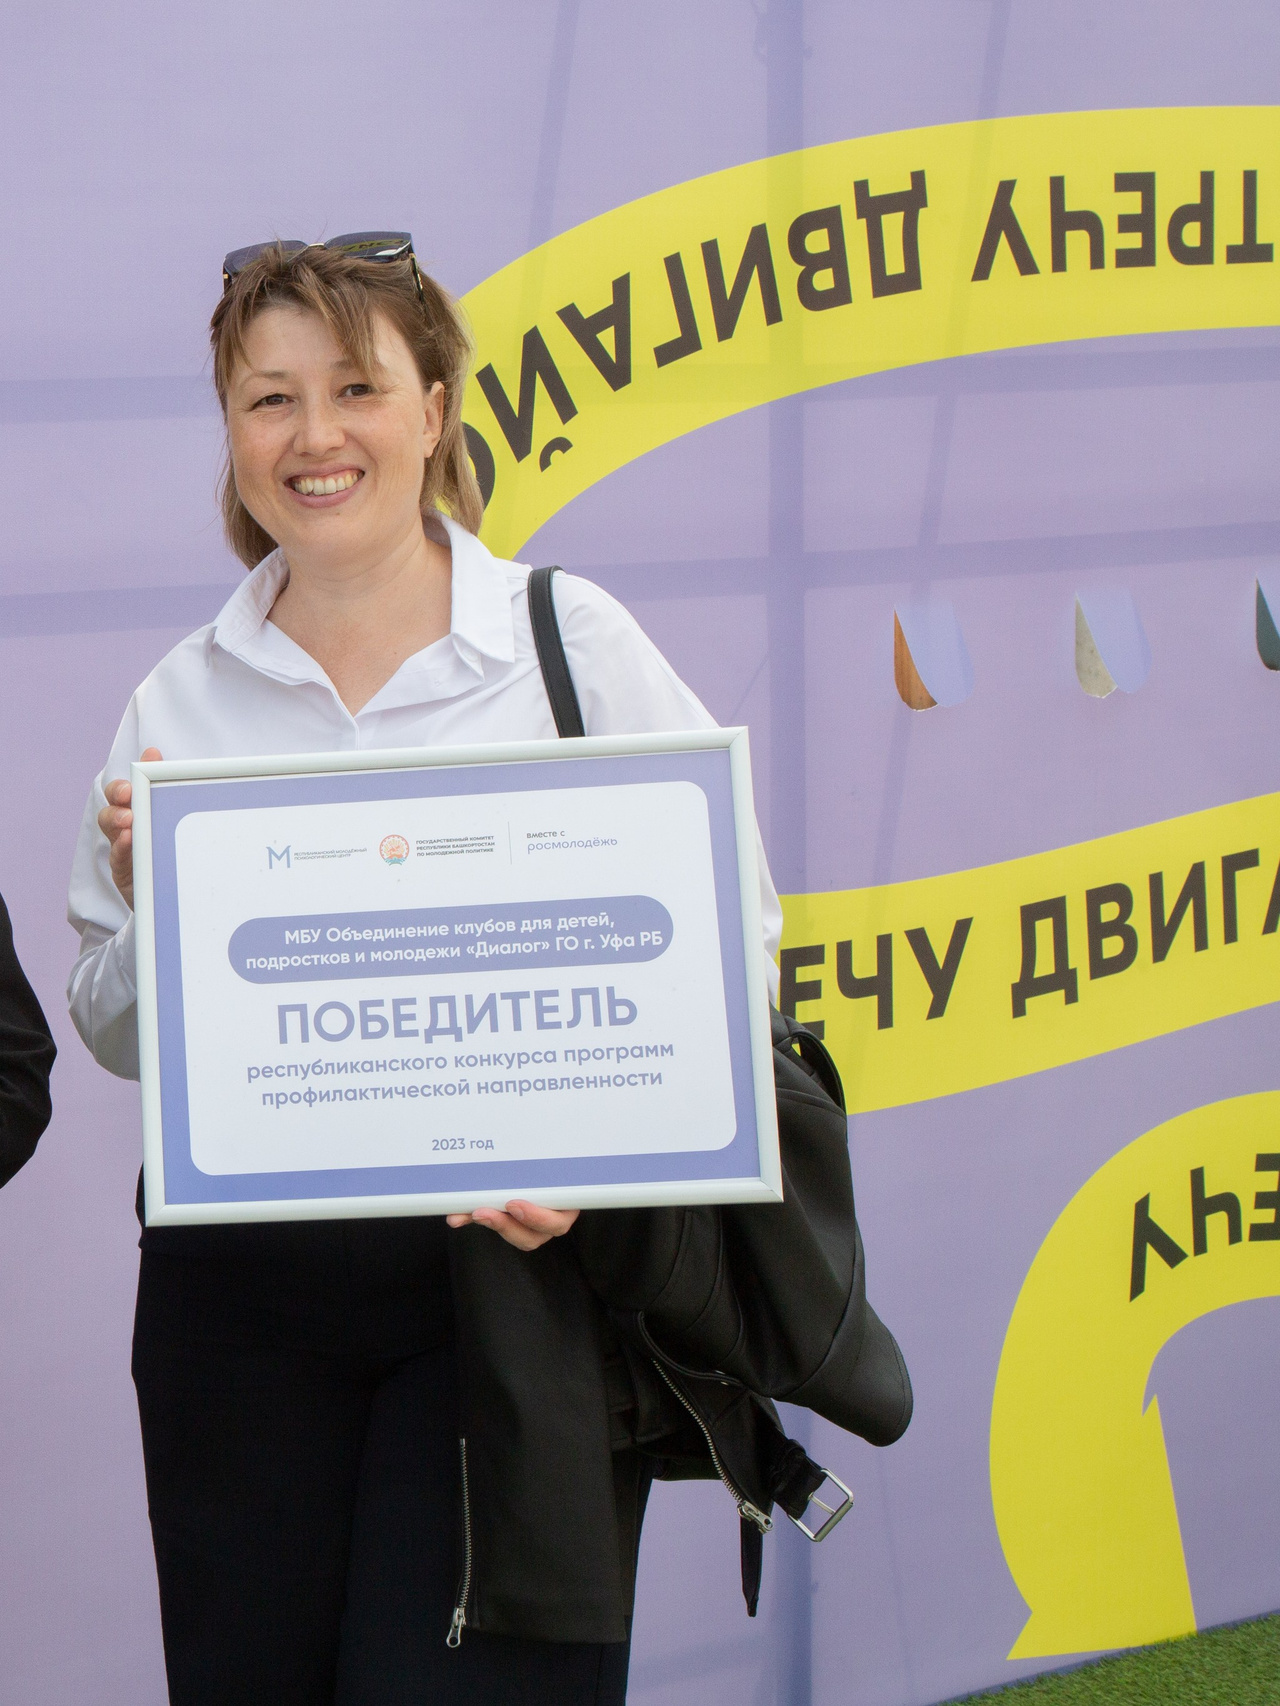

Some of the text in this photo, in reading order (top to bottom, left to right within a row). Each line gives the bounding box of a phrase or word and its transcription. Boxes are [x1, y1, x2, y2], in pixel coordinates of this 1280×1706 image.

[970, 169, 1274, 282] ТРЕЧУ
[416, 836, 469, 845] ГОСУДАРСТВЕННЫЙ
[452, 841, 496, 849] БАШКОРТОСТАН
[526, 830, 558, 839] вместе
[527, 837, 618, 855] росмолодёжь
[285, 912, 615, 945] МБУ Объединение клубов для детей,
[246, 931, 664, 971] подростков и молодежи «Диалог» ГО г. Уфа РБ
[780, 917, 974, 1044] ЕЧУ
[277, 986, 638, 1044] ПОБЕДИТЕЛЬ
[247, 1042, 674, 1084] республиканского конкурса программ
[261, 1070, 663, 1109] профилактической направленности
[431, 1138, 495, 1151] 2023 год
